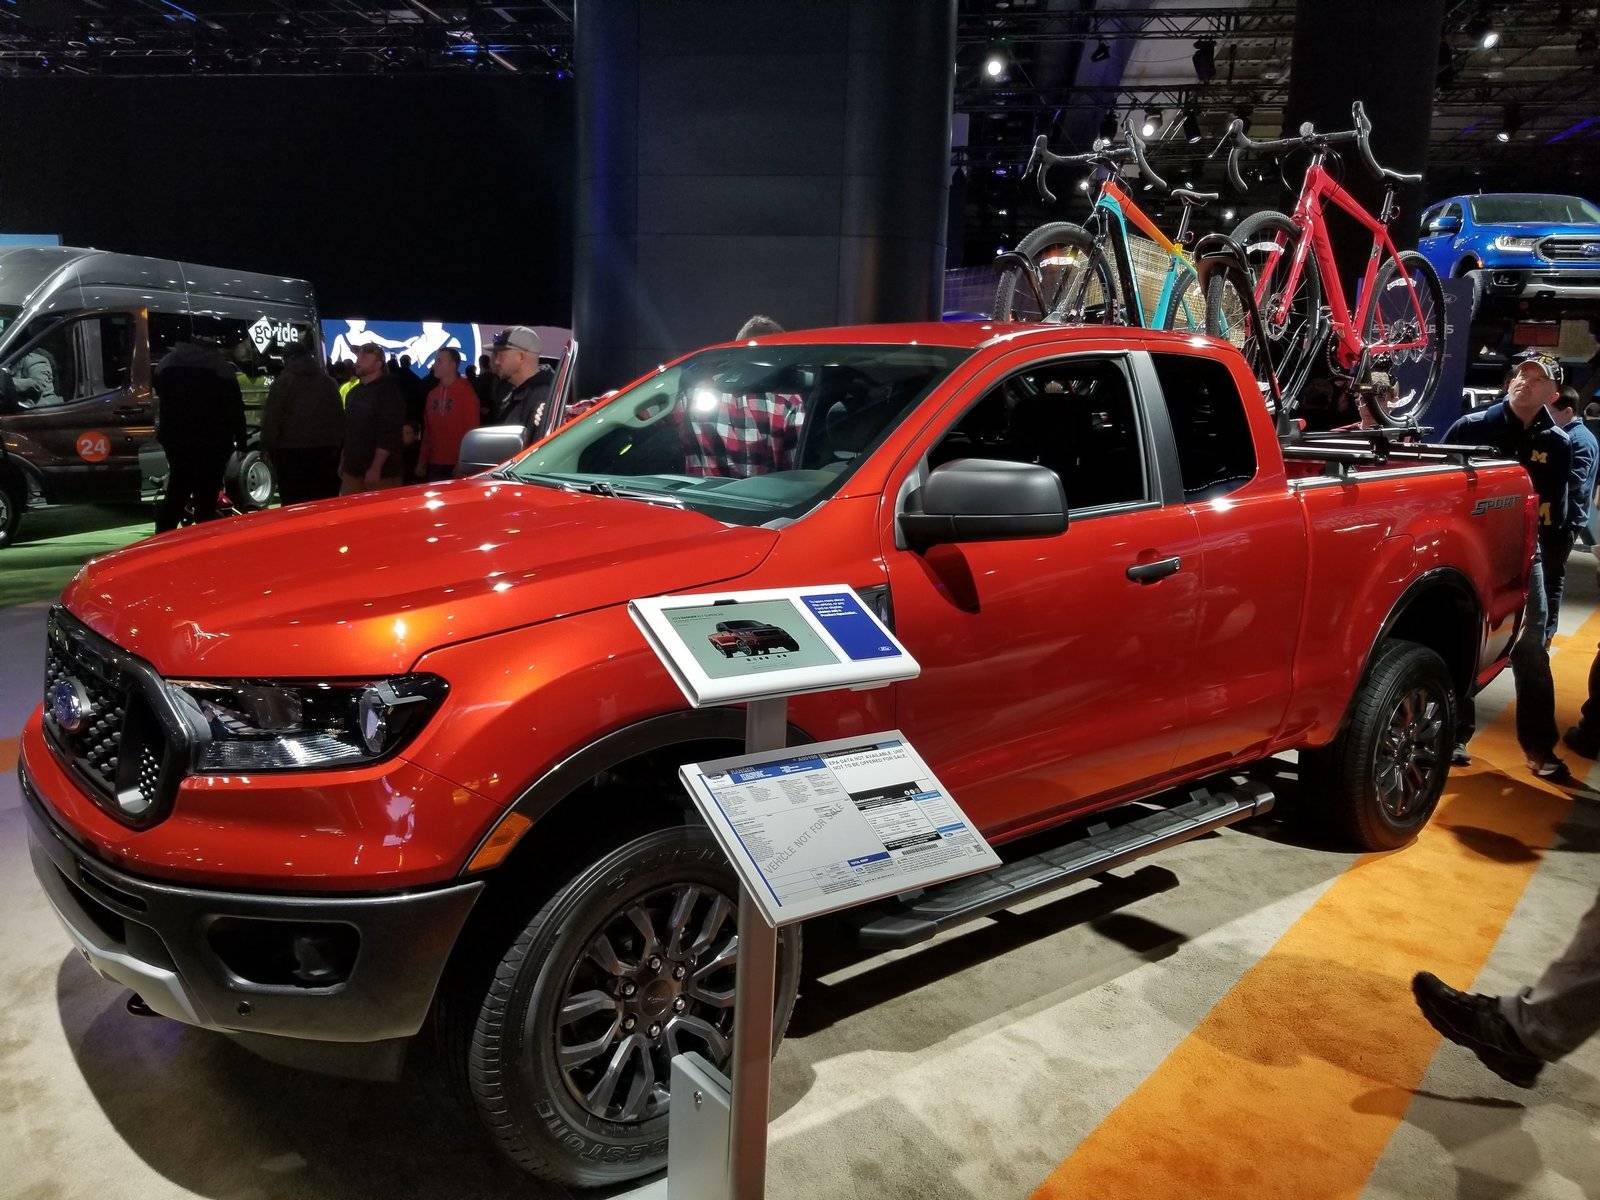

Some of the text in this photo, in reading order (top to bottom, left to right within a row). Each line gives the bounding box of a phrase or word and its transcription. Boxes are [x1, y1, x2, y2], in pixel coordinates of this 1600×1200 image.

[81, 439, 106, 455] 24
[1531, 450, 1548, 463] M
[1472, 494, 1520, 516] SPORT
[860, 758, 883, 766] OFFERED
[764, 846, 796, 874] VEHICLE
[793, 831, 811, 848] NOT
[809, 818, 827, 834] FOR
[826, 803, 844, 820] SALE
